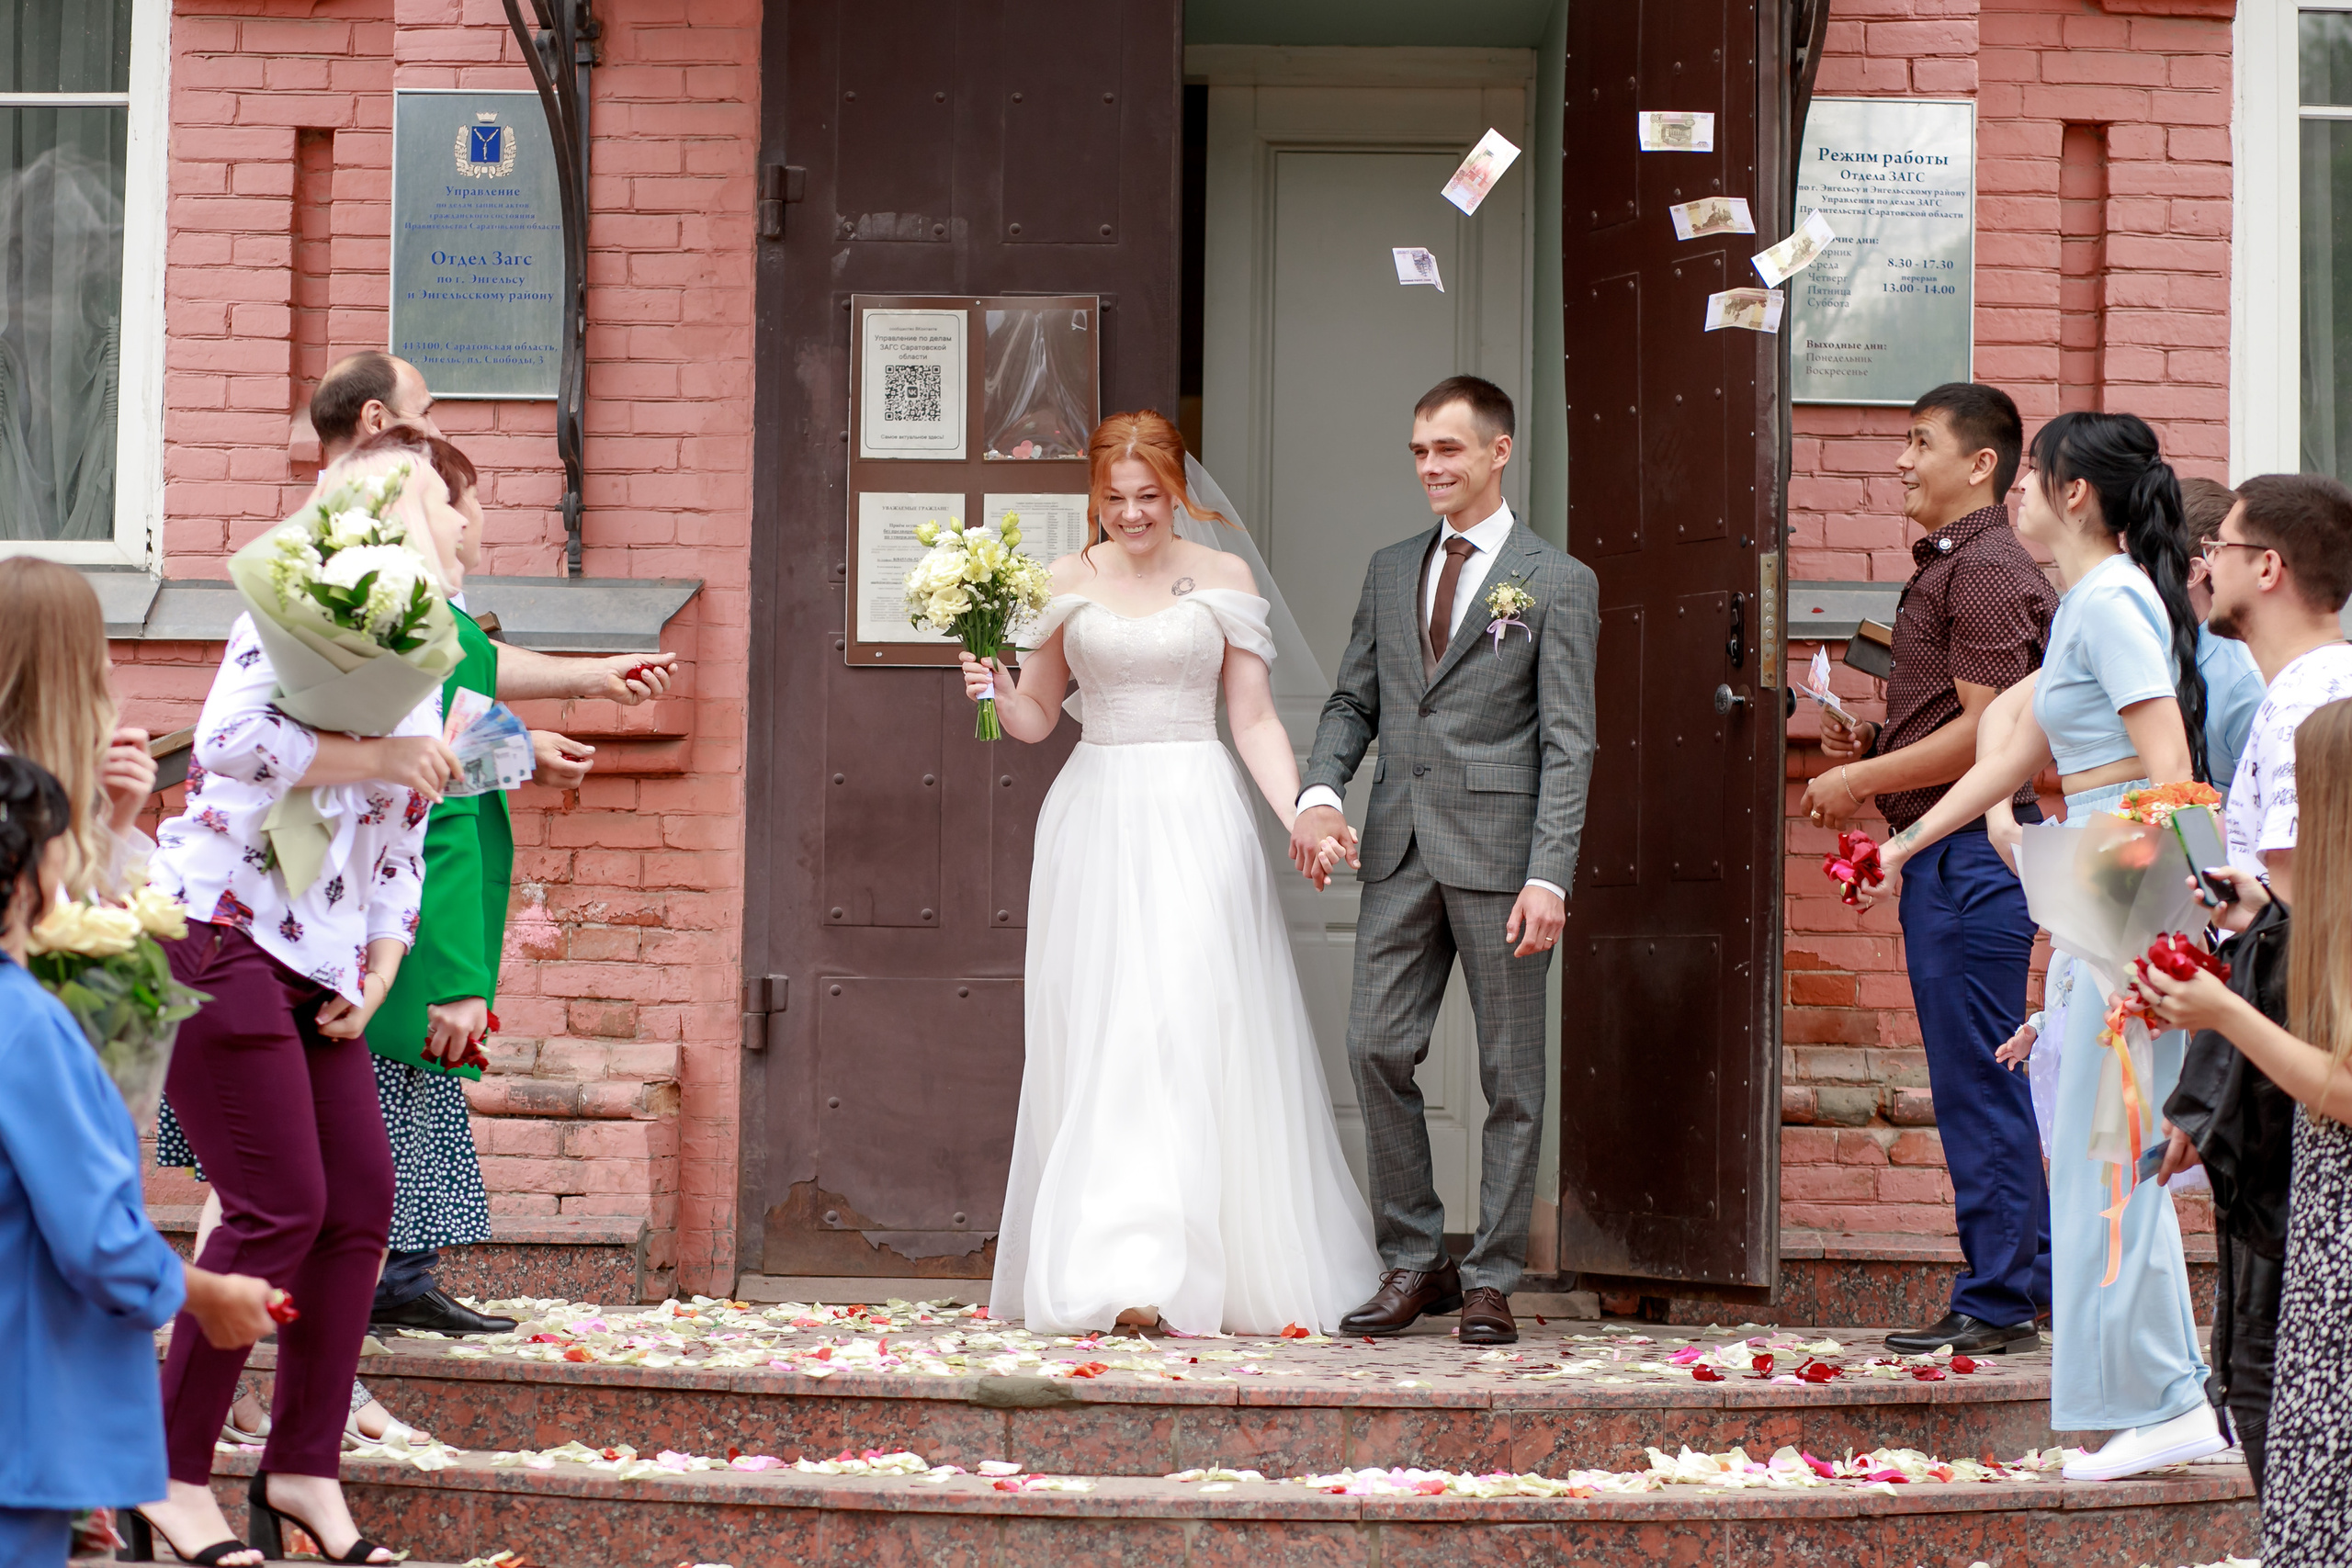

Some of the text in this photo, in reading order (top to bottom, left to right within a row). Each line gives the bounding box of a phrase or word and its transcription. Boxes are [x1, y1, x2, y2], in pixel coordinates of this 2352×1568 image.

[1817, 147, 1949, 167] Режим работы
[1840, 170, 1926, 183] Отдела ЗАГС
[446, 186, 521, 198] Управление
[1820, 185, 1861, 195] Энгельсу
[1870, 186, 1932, 197] Энгельсскому
[1934, 187, 1966, 198] району
[1821, 195, 1874, 206] Управления
[1889, 198, 1916, 207] делам
[1917, 197, 1943, 208] ЗАГС
[1868, 208, 1926, 219] Саратовской
[1928, 209, 1963, 219] области
[526, 222, 560, 231] области
[1856, 236, 1879, 245] дни:
[431, 251, 533, 267] Отдел Загс
[1820, 249, 1851, 258] орник
[1808, 260, 1839, 270] Среда
[1887, 258, 1913, 268] 8.30
[1922, 259, 1954, 270] 17.30
[469, 275, 526, 285] Энгельсу
[1808, 272, 1848, 285] Четверг
[1807, 286, 1851, 296] Пятница
[1883, 283, 1914, 293] 13.00
[1924, 285, 1955, 295] 14.00
[418, 289, 505, 301] Энгельсскому
[509, 290, 554, 302] району
[1807, 298, 1849, 308] Суббота
[875, 334, 918, 343] Управление
[401, 342, 559, 353] 413100, Саратовская область,
[899, 344, 946, 353] Саратовской
[1806, 340, 1887, 351] Выходные дни:
[422, 355, 465, 365] Энгельс,
[484, 355, 536, 366] Свободы,
[538, 355, 544, 364] 3
[899, 353, 928, 361] области
[1805, 352, 1873, 364] Понедельник
[1805, 366, 1869, 378] Воскресенье
